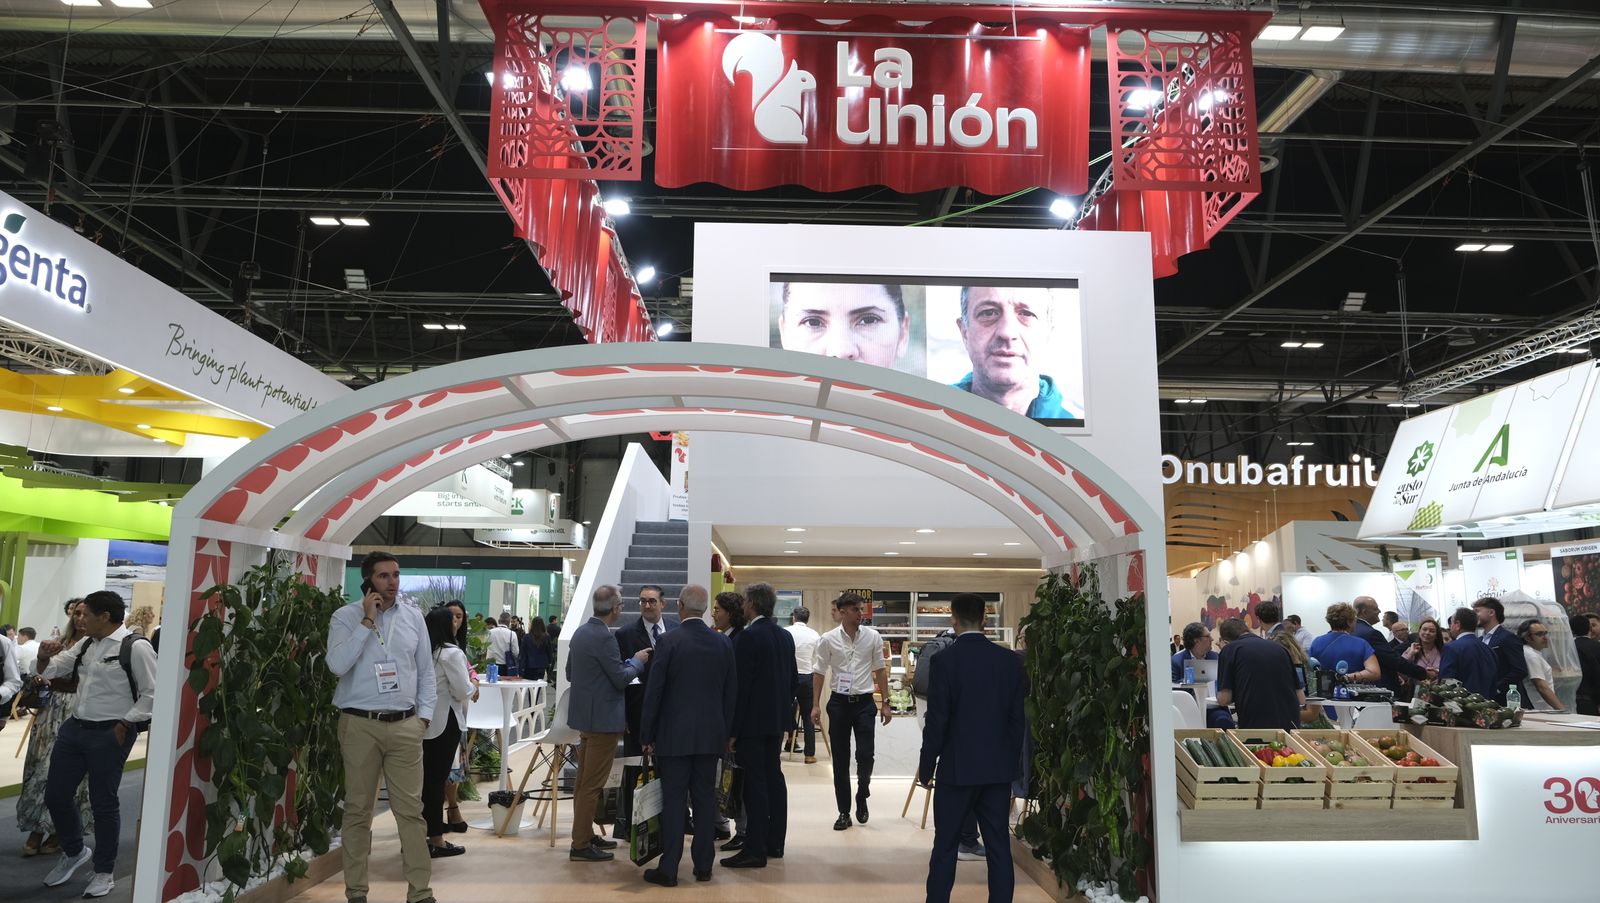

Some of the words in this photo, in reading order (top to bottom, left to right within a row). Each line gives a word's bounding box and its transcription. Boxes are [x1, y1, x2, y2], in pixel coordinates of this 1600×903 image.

[836, 41, 913, 89] La
[836, 92, 1038, 150] Unión
[165, 323, 224, 385] Bringing
[226, 361, 264, 393] plant
[262, 380, 313, 412] potential
[1162, 454, 1379, 488] Onubafruit
[1448, 482, 1472, 492] Junta
[1472, 476, 1483, 487] de
[1483, 465, 1529, 485] Andalucía
[1543, 777, 1600, 814] 30
